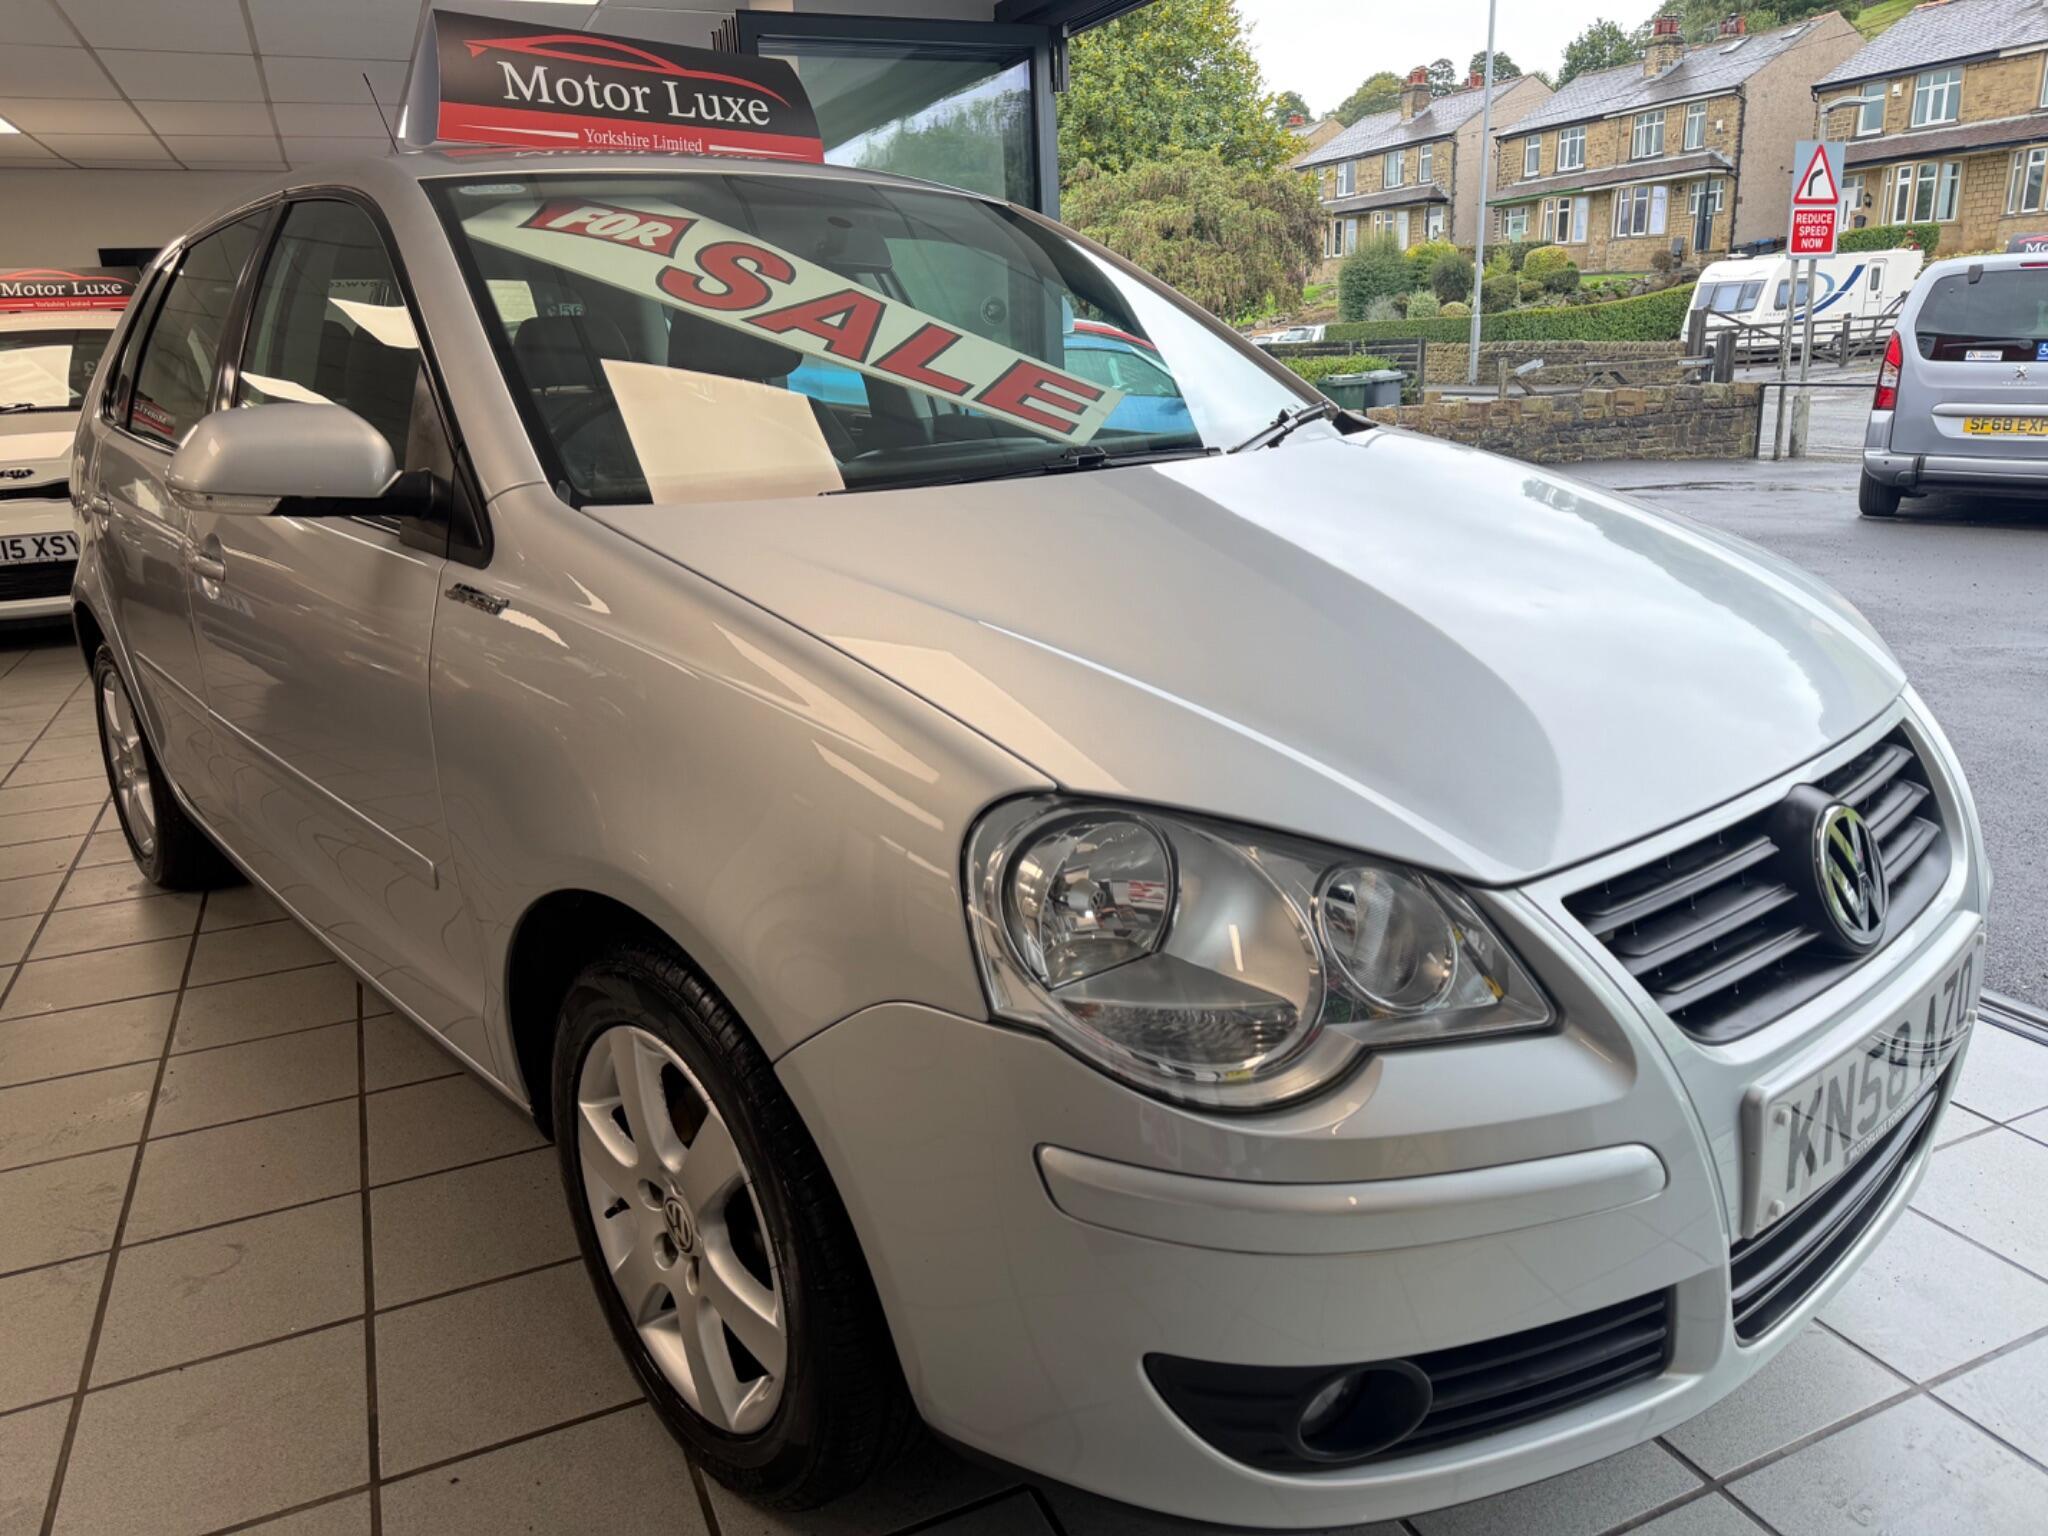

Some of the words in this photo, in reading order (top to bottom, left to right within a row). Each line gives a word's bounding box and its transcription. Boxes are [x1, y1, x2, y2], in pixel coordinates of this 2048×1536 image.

[497, 61, 650, 113] Motor
[663, 81, 770, 126] Luxe
[583, 128, 650, 147] Yorkshire
[652, 134, 703, 152] Limited
[545, 206, 673, 246] FOR
[1795, 213, 1833, 224] REDUCE
[1798, 225, 1829, 237] SPEED
[1800, 238, 1824, 249] NOW
[0, 281, 65, 296] Motor
[71, 281, 123, 295] Luxe
[656, 241, 1106, 435] SALE
[1969, 416, 2013, 431] SF68
[1785, 1021, 1912, 1193] KN58
